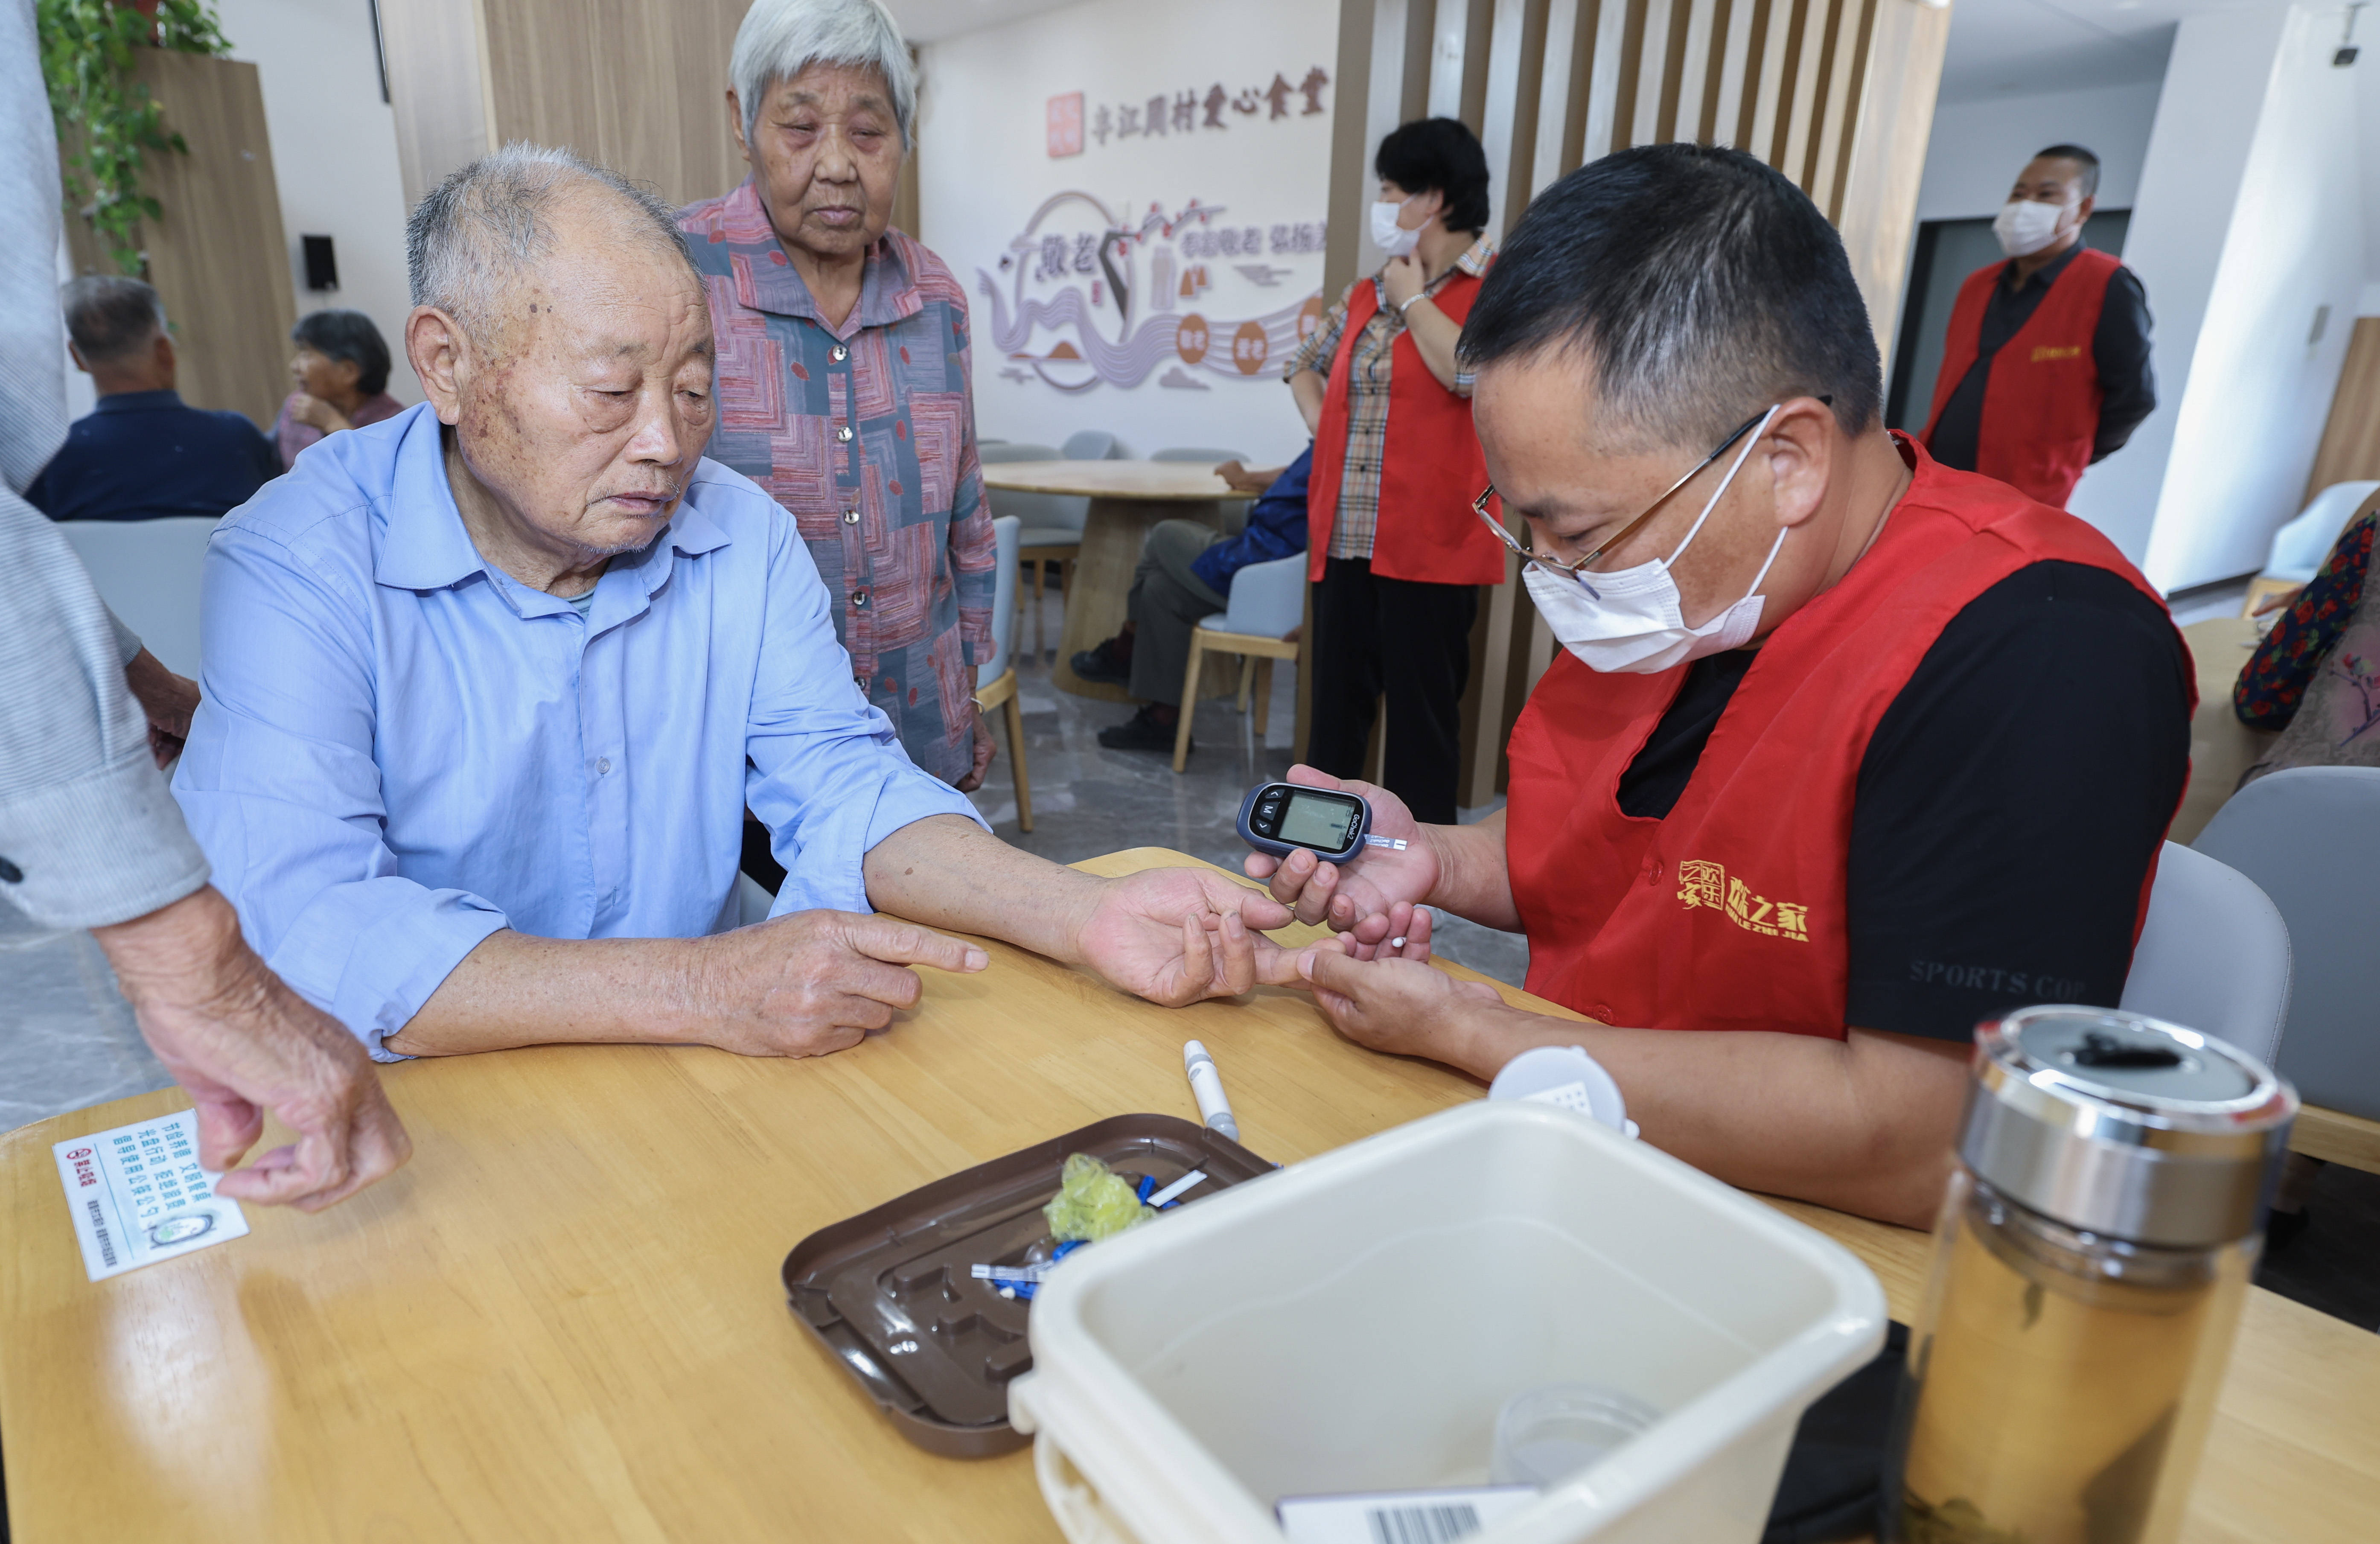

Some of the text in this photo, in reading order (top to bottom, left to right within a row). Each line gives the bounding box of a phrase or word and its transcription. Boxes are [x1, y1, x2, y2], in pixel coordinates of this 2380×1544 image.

[1263, 805, 1273, 814] M
[1347, 813, 1360, 840] GoChek2
[1752, 923, 1780, 936] ZHI
[1782, 930, 1810, 942] JIA
[1909, 958, 2028, 995] SPORTS
[74, 1159, 97, 1187] 禁止吸烟
[113, 1135, 159, 1218] 倡导使用公筷公勺
[137, 1129, 186, 1215] 光盘行动 拒绝浪费
[179, 1162, 211, 1203] 文明餐桌
